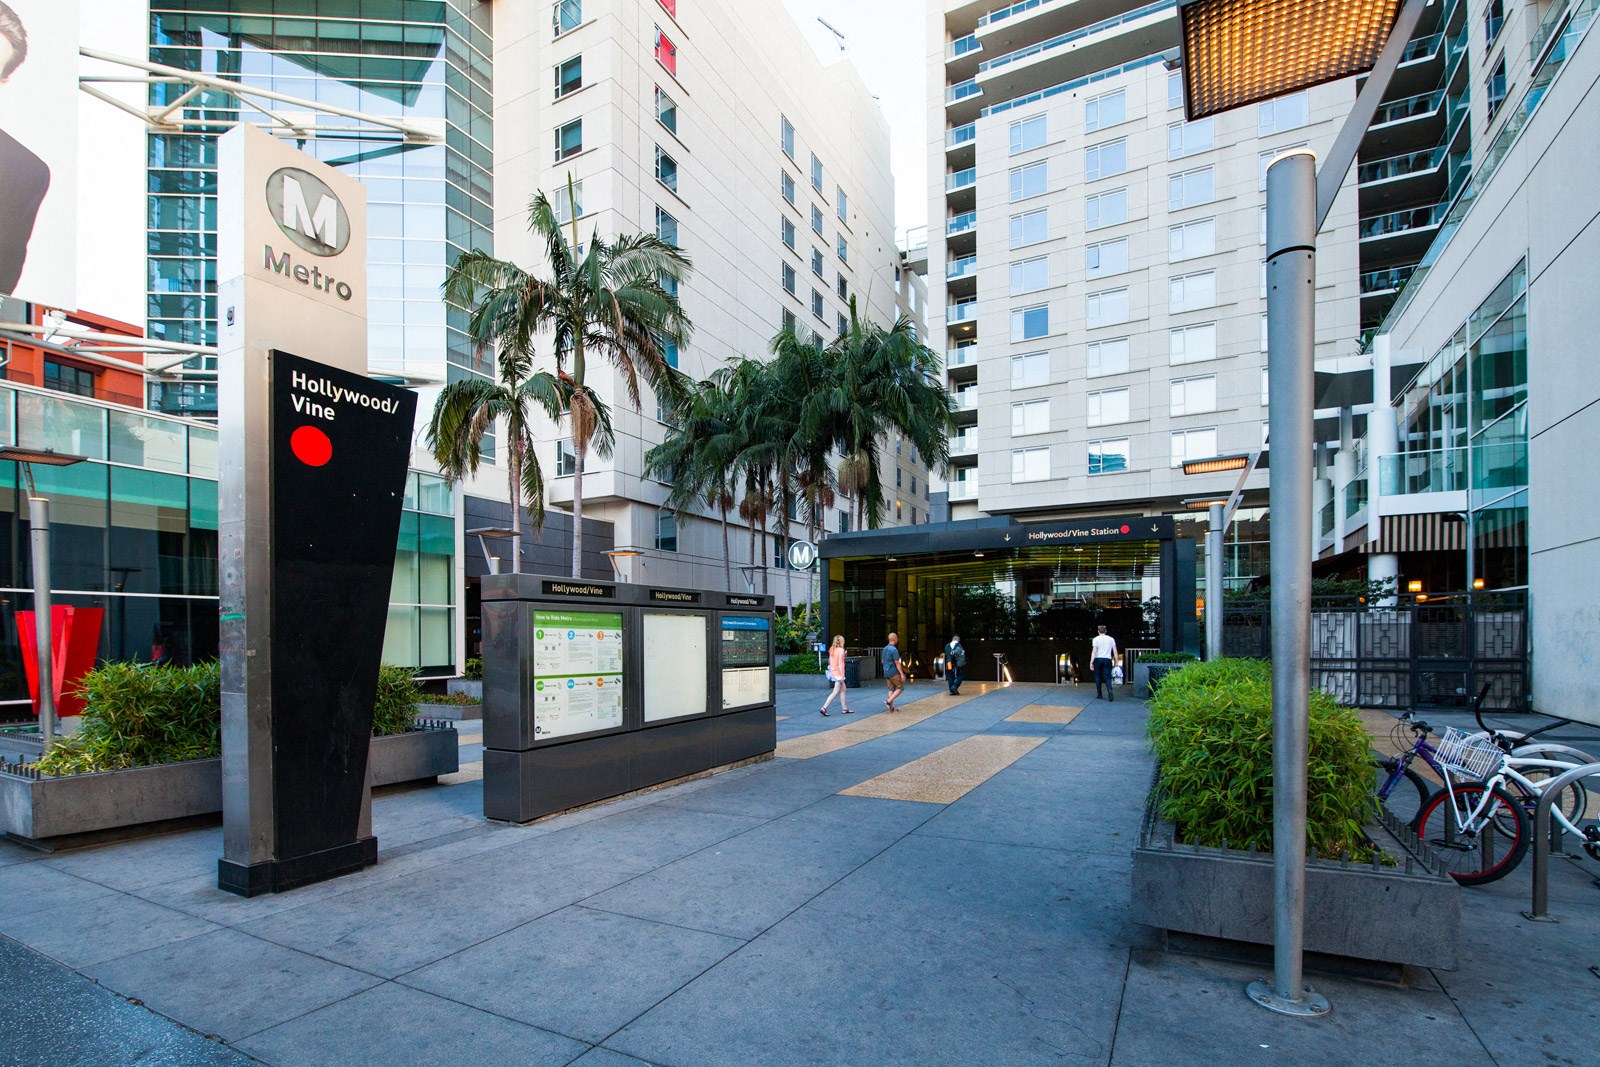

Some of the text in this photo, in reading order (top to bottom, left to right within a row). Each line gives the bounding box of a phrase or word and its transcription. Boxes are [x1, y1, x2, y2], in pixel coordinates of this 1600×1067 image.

[283, 175, 337, 249] M
[263, 244, 353, 301] Metro
[292, 370, 399, 415] Hollywood/
[290, 393, 335, 421] Vine
[1028, 527, 1119, 540] Hollywood/Vine Station
[793, 546, 809, 564] M
[551, 584, 603, 595] Hollywood/Vine
[655, 591, 692, 601] Hollywood/Vine
